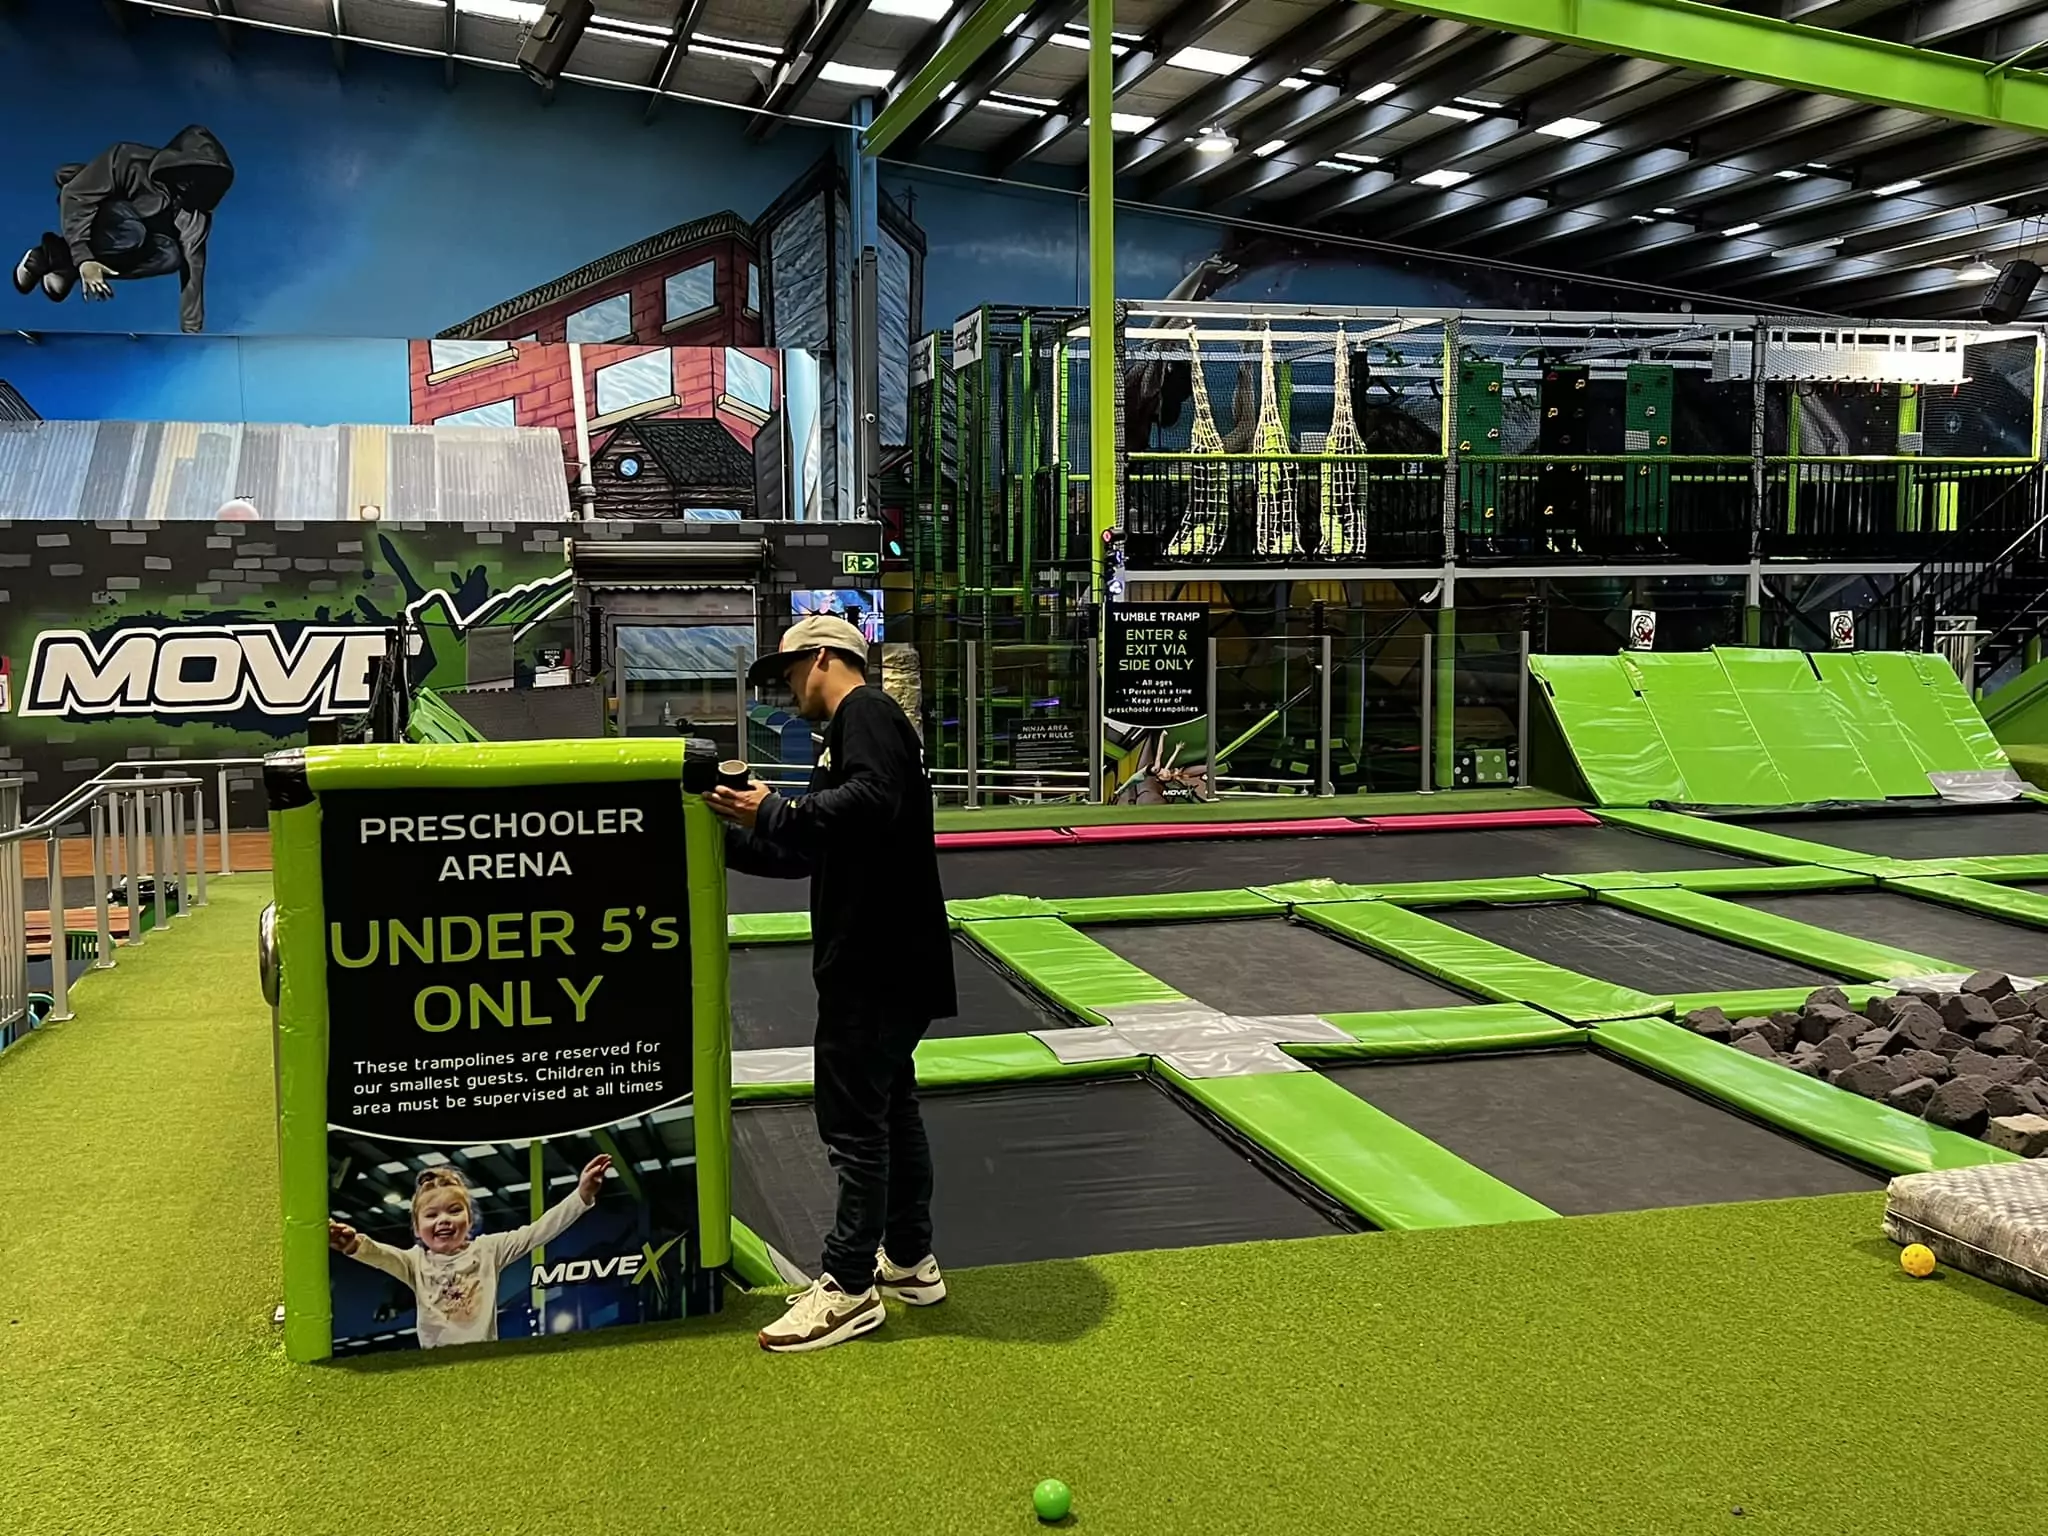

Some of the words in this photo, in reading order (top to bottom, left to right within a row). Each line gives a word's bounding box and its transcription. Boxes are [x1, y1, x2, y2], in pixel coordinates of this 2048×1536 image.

[1112, 612, 1157, 621] TUMBLE
[1160, 612, 1200, 621] TRAMP
[1126, 629, 1174, 640] ENTER
[1178, 630, 1188, 640] &
[1126, 644, 1158, 655] EXIT
[1162, 644, 1187, 655] VIA
[549, 659, 556, 668] 3
[1119, 659, 1150, 670] SIDE
[1155, 659, 1194, 670] ONLY
[1108, 706, 1152, 714] preschooler
[1174, 696, 1182, 704] of
[360, 808, 644, 844] PRESCHOOLER
[438, 851, 573, 881] ARENA
[330, 910, 576, 969] UNDER
[601, 905, 680, 953] 5's
[414, 975, 604, 1033] ONLY
[353, 1060, 408, 1075] These
[415, 1051, 515, 1072] trampolines
[521, 1050, 549, 1062] are
[555, 1041, 630, 1060] reserved
[636, 1040, 661, 1054] for
[353, 1083, 383, 1095] our
[390, 1076, 460, 1093] smallest
[466, 1072, 529, 1090] guests.
[535, 1065, 604, 1082] Children
[610, 1062, 625, 1075] in
[631, 1059, 661, 1073] this
[352, 1102, 391, 1116] area
[397, 1099, 439, 1112] must
[446, 1095, 467, 1108] be
[473, 1085, 567, 1107] supervised
[573, 1085, 589, 1097] at
[595, 1081, 613, 1095] all
[619, 1079, 664, 1094] times
[530, 1230, 688, 1301] MOVEX
